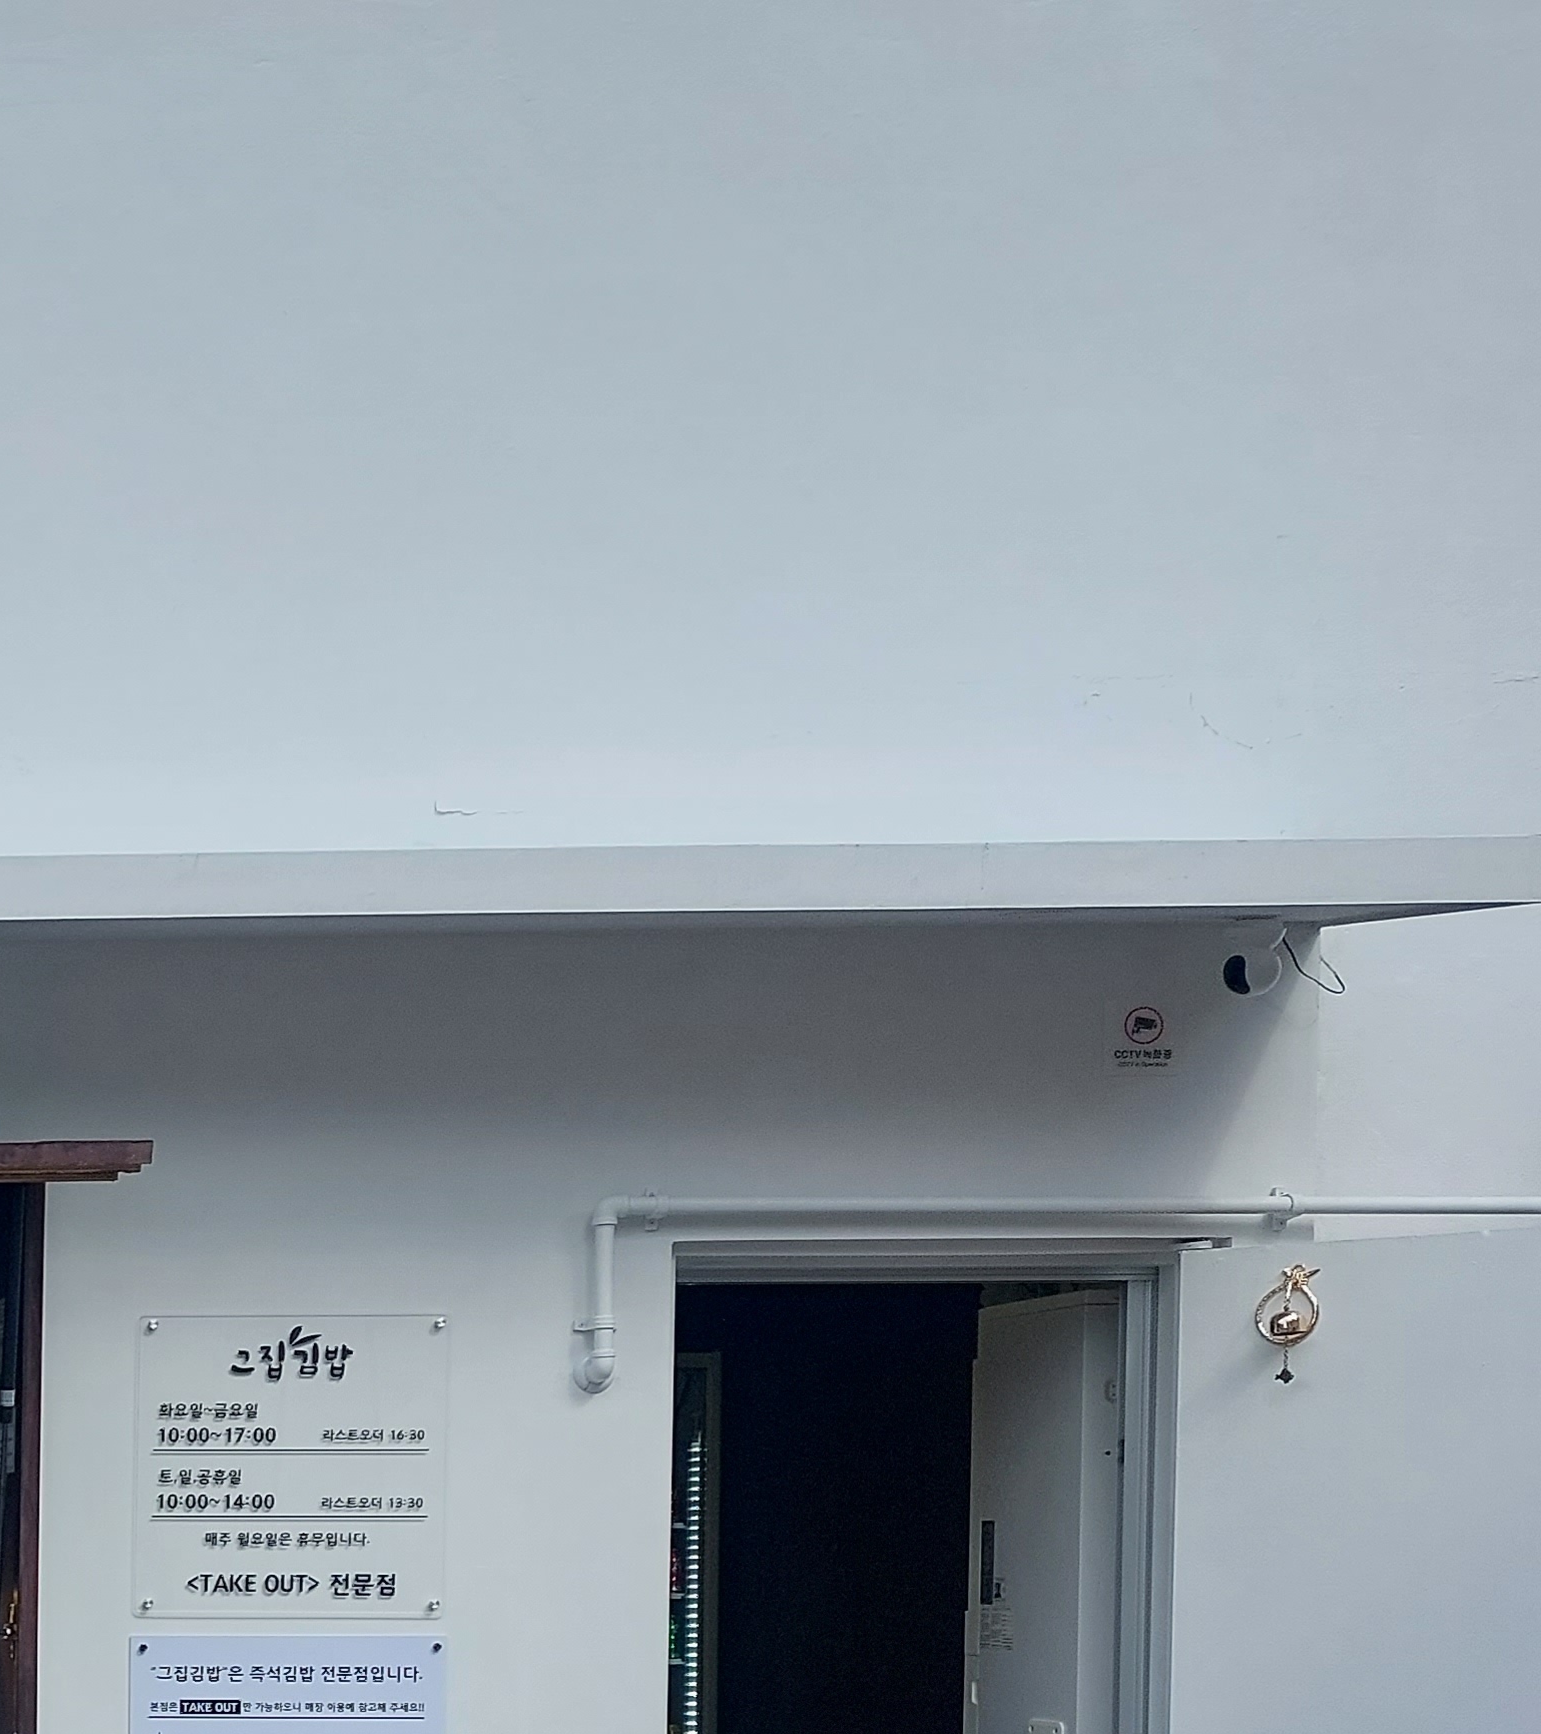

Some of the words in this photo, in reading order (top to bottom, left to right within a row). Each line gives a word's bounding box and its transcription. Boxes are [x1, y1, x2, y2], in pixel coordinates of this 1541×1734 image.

[230, 1340, 354, 1380] 그집김밥
[158, 1403, 259, 1419] 화요일~금요일
[157, 1427, 277, 1443] 10:00~17:00
[323, 1429, 384, 1441] 라스트오더
[390, 1429, 426, 1441] 16:30
[157, 1493, 275, 1510] 10:00~14:00
[321, 1497, 383, 1509] 라스트오더
[389, 1497, 424, 1509] 13:30
[204, 1532, 232, 1546] 매주
[237, 1532, 293, 1546] 월요일은
[297, 1532, 371, 1546] 휴무입니다.
[186, 1574, 257, 1593] <TAKE
[264, 1574, 320, 1593] OUT>
[329, 1573, 397, 1597] 전문점
[249, 1665, 315, 1683] 즉석김밥
[321, 1665, 424, 1683] 전문점입니다.
[182, 1702, 213, 1713] TAKE
[215, 1702, 239, 1713] OUT
[305, 1702, 324, 1713] 매장
[327, 1702, 355, 1713] 이용에
